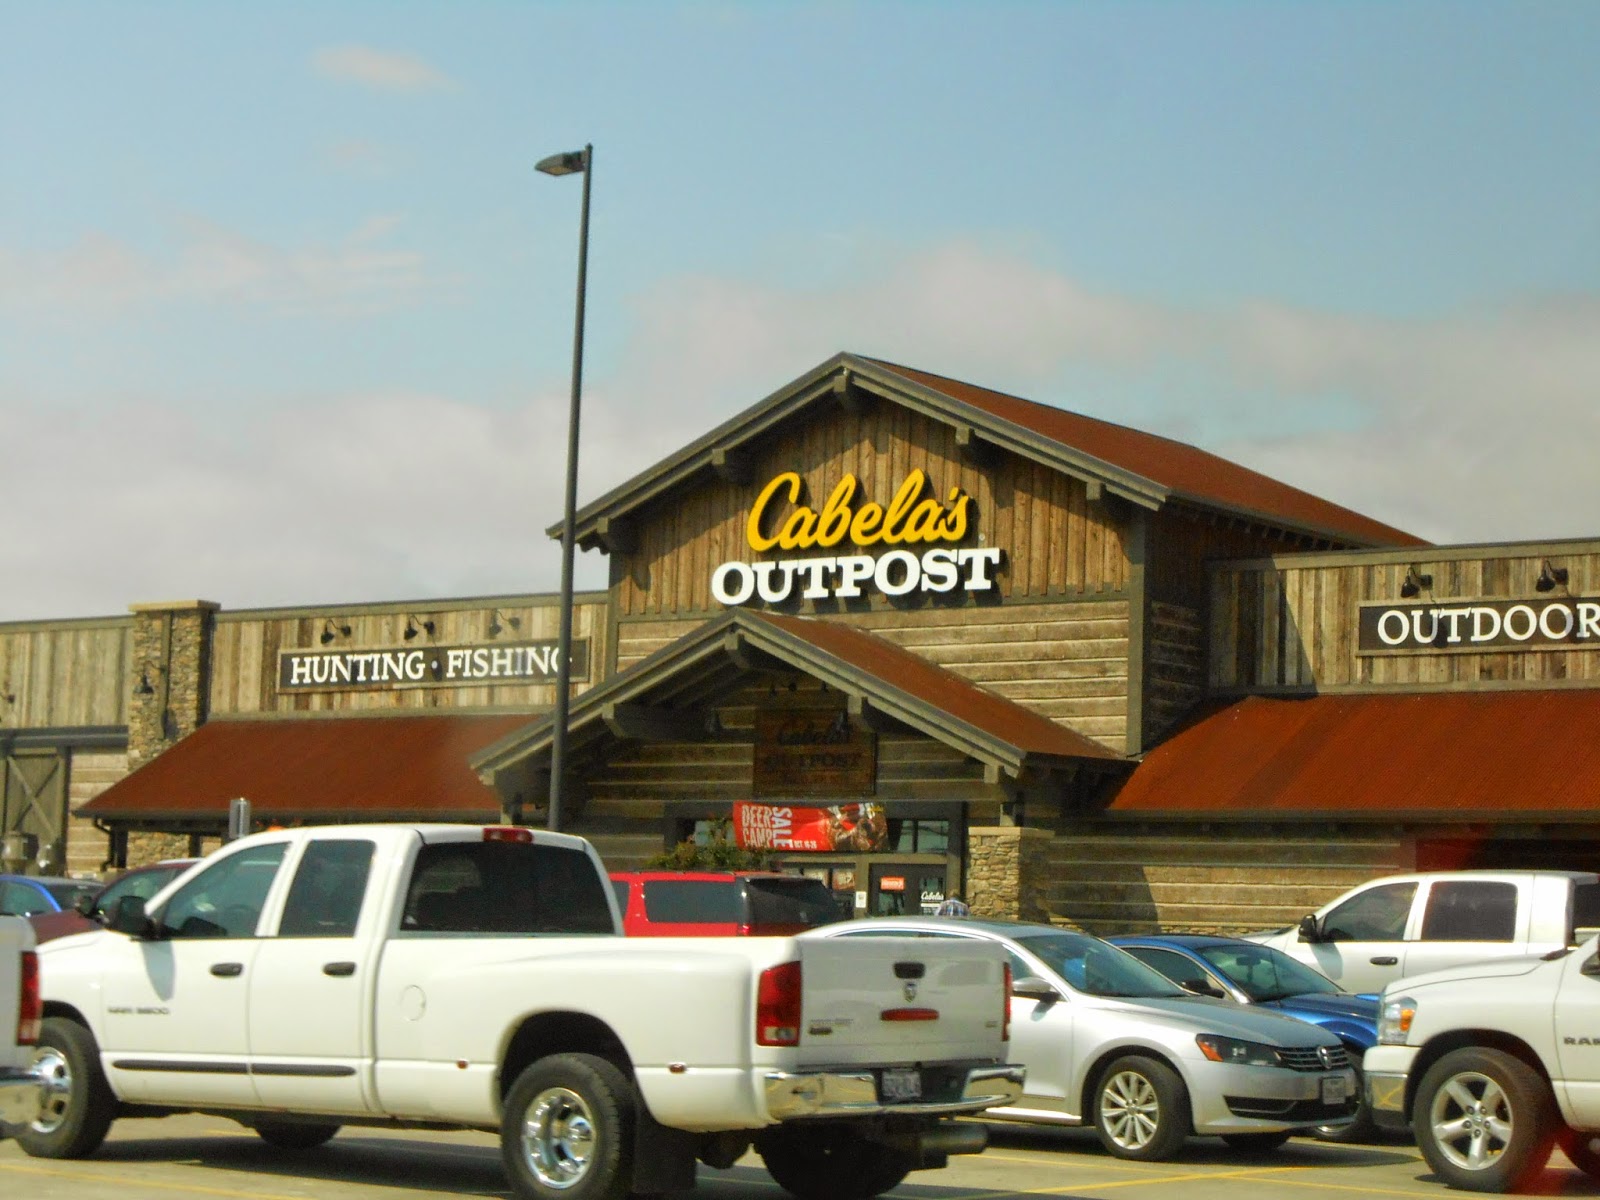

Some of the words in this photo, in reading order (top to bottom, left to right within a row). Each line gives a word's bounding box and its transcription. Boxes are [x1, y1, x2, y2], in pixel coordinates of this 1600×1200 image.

[747, 468, 969, 552] Cabela's
[711, 547, 1000, 606] OUTPOST
[1377, 603, 1600, 645] OUTDOOR
[290, 651, 425, 684] HUNTING
[742, 804, 772, 828] DEER
[772, 806, 793, 849] SALE
[742, 827, 772, 849] CAMP
